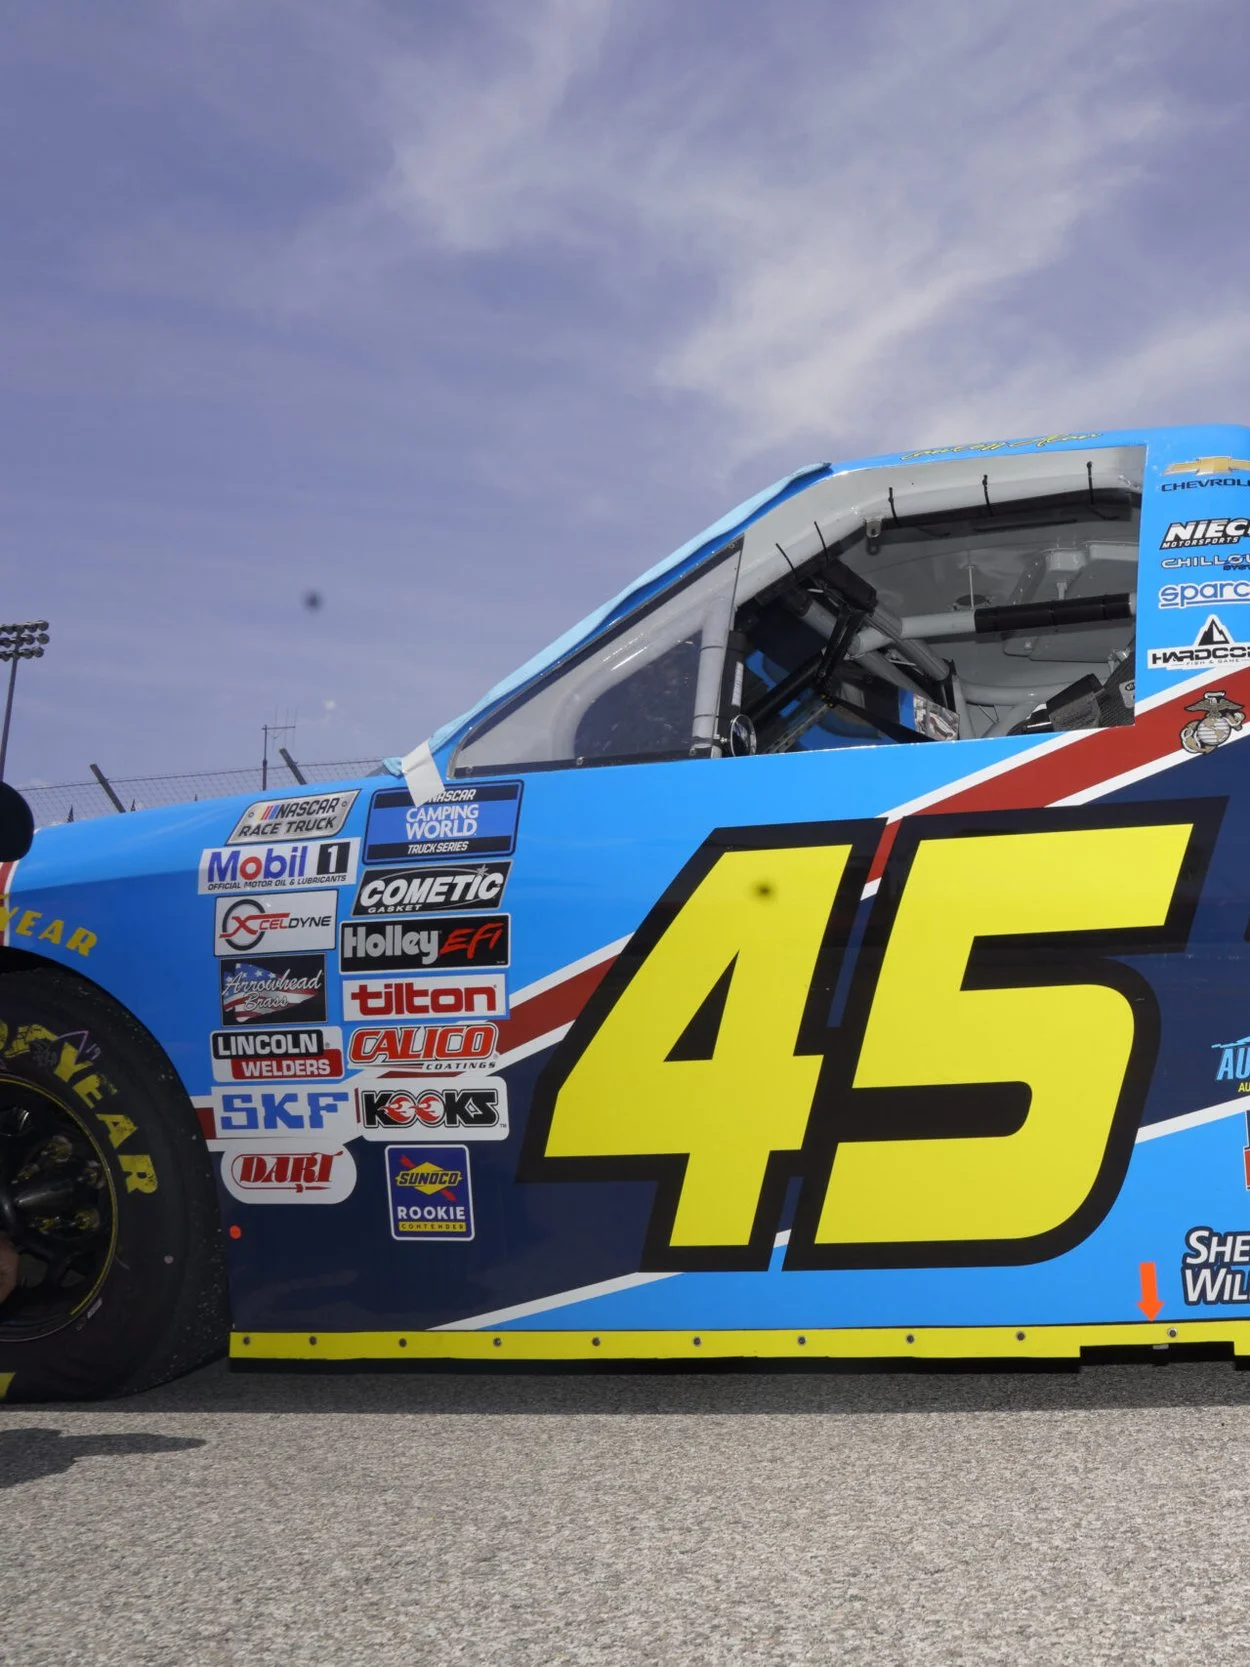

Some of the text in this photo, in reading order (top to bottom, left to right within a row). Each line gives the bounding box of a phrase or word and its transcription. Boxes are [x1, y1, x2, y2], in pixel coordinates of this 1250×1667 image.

[1161, 537, 1240, 548] MOTORSPORTS
[275, 798, 340, 819] NASCAR
[406, 804, 479, 822] CAMPING
[238, 816, 337, 837] RACE TRUCK
[406, 819, 478, 840] WORLD
[408, 841, 469, 855] TRUCK SERIES
[208, 846, 308, 883] Mobil
[208, 881, 241, 891] OFFICIAL
[244, 880, 273, 888] MOTOR
[275, 879, 287, 887] OIL
[298, 874, 347, 885] LUBRICANTS
[360, 872, 504, 907] COMETIC
[368, 904, 422, 914] GASKET
[219, 912, 332, 939] XCELDYNE
[343, 925, 439, 965] Holley
[222, 969, 322, 998] Arrowhead
[244, 994, 288, 1011] Brass
[351, 982, 496, 1016] tilton
[217, 1033, 318, 1056] LINCOLN
[350, 1025, 496, 1062] CALICO
[544, 824, 1194, 1247] 45
[242, 1058, 331, 1078] WELDERS
[424, 1060, 496, 1071] COATINGS
[220, 1092, 350, 1130] SKF
[363, 1090, 498, 1127] KOOKS
[240, 1152, 337, 1184] DART
[399, 1172, 459, 1185] SUNOCO
[397, 1206, 466, 1220] ROOKIE
